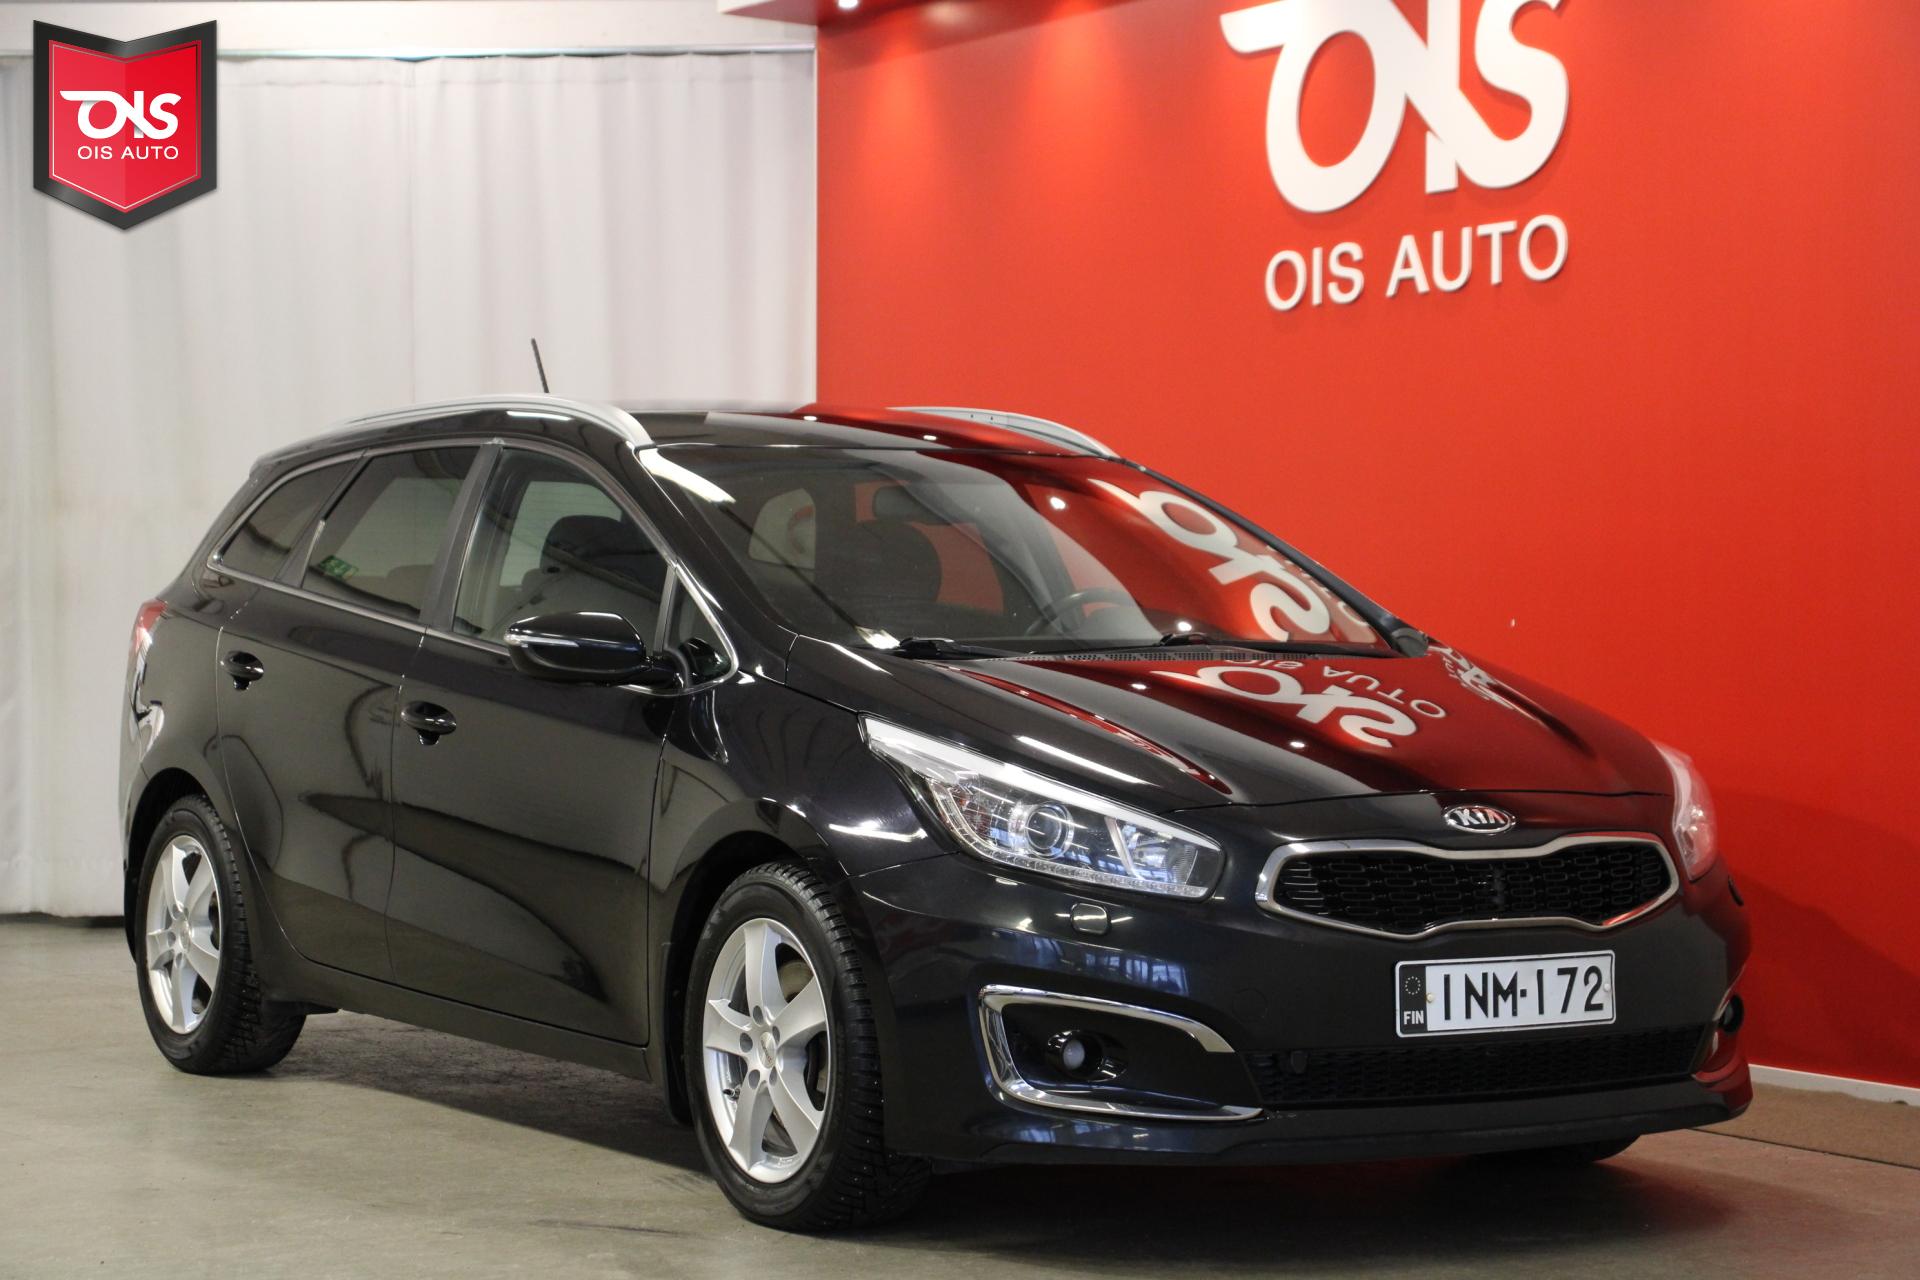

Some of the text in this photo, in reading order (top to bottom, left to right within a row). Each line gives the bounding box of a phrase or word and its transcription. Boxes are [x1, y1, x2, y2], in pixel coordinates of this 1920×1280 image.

[1220, 0, 1569, 213] OIS
[1265, 215, 1568, 311] OIS AUTO
[1454, 808, 1505, 826] KIA
[1403, 1010, 1424, 1025] FIN
[1443, 966, 1604, 1020] INM-172
